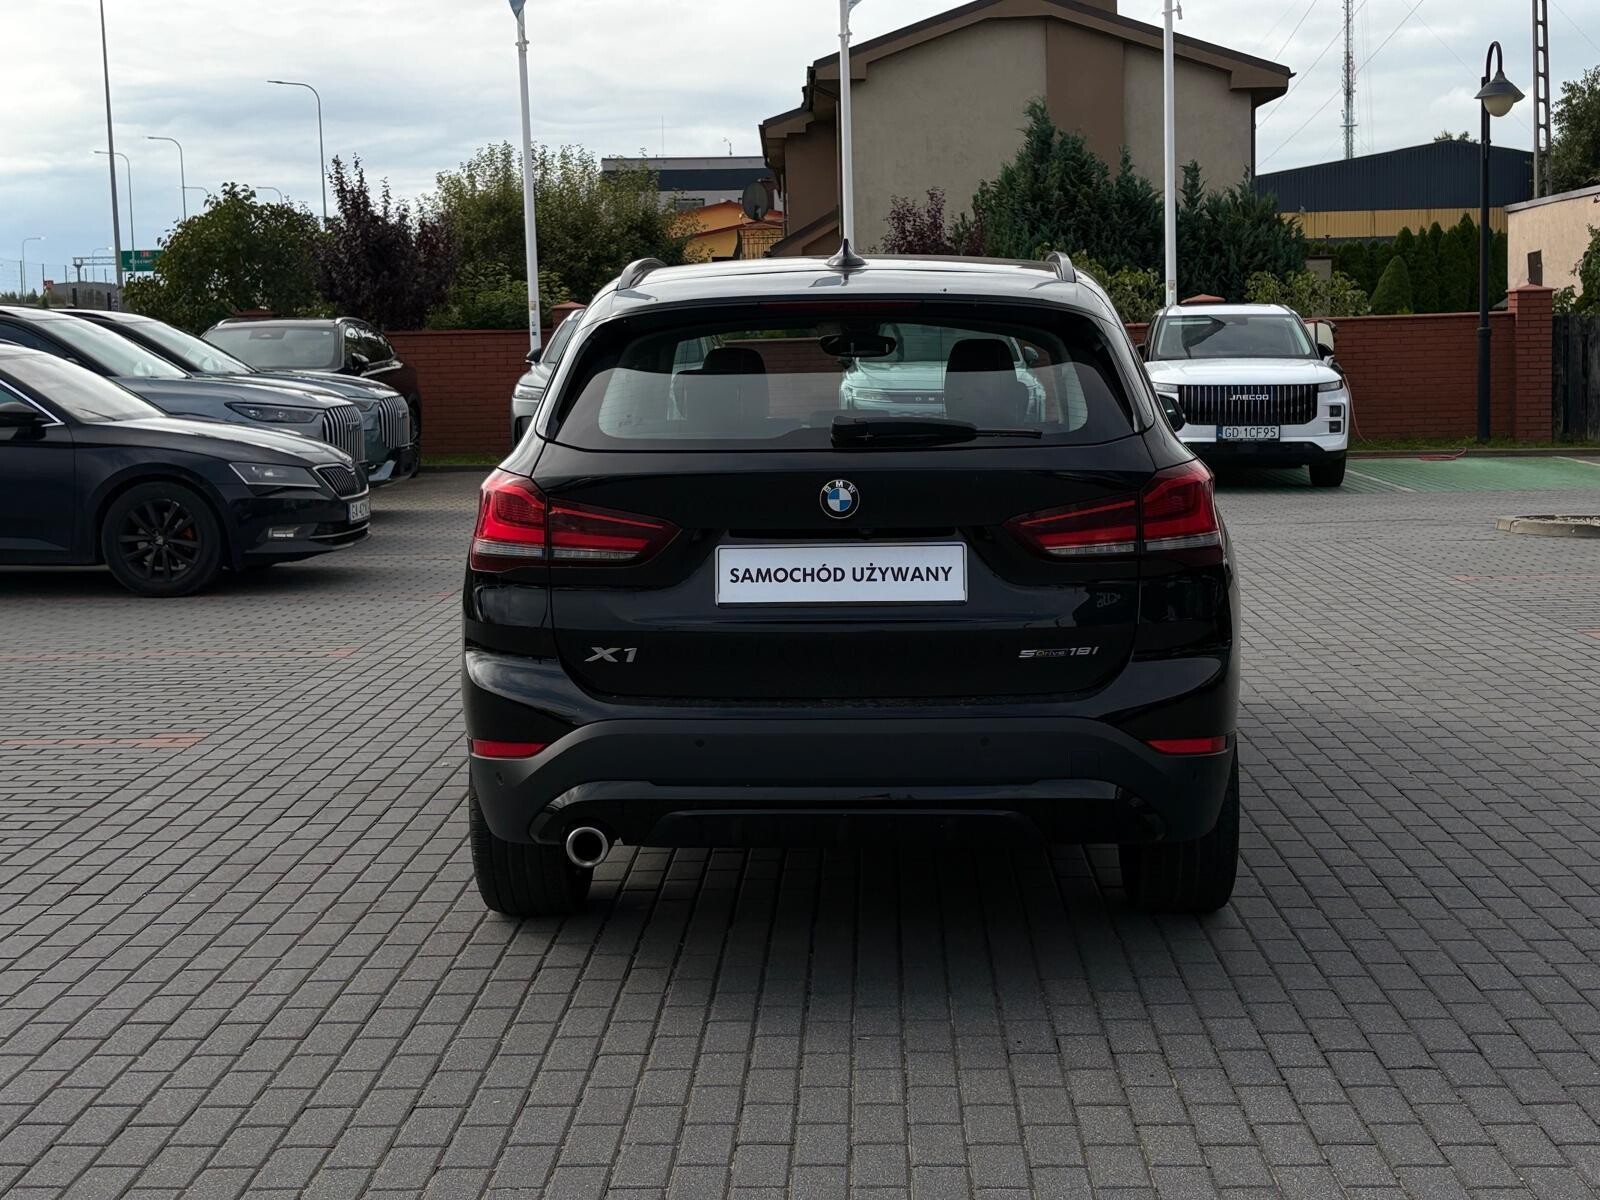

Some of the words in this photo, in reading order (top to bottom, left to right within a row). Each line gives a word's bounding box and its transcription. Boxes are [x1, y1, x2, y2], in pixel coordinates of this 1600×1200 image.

[1224, 427, 1240, 438] GD
[1244, 427, 1277, 438] 1CF95
[729, 563, 846, 584] SAMOCHÓD
[851, 562, 953, 583] UŻYWANY
[584, 646, 638, 663] X1
